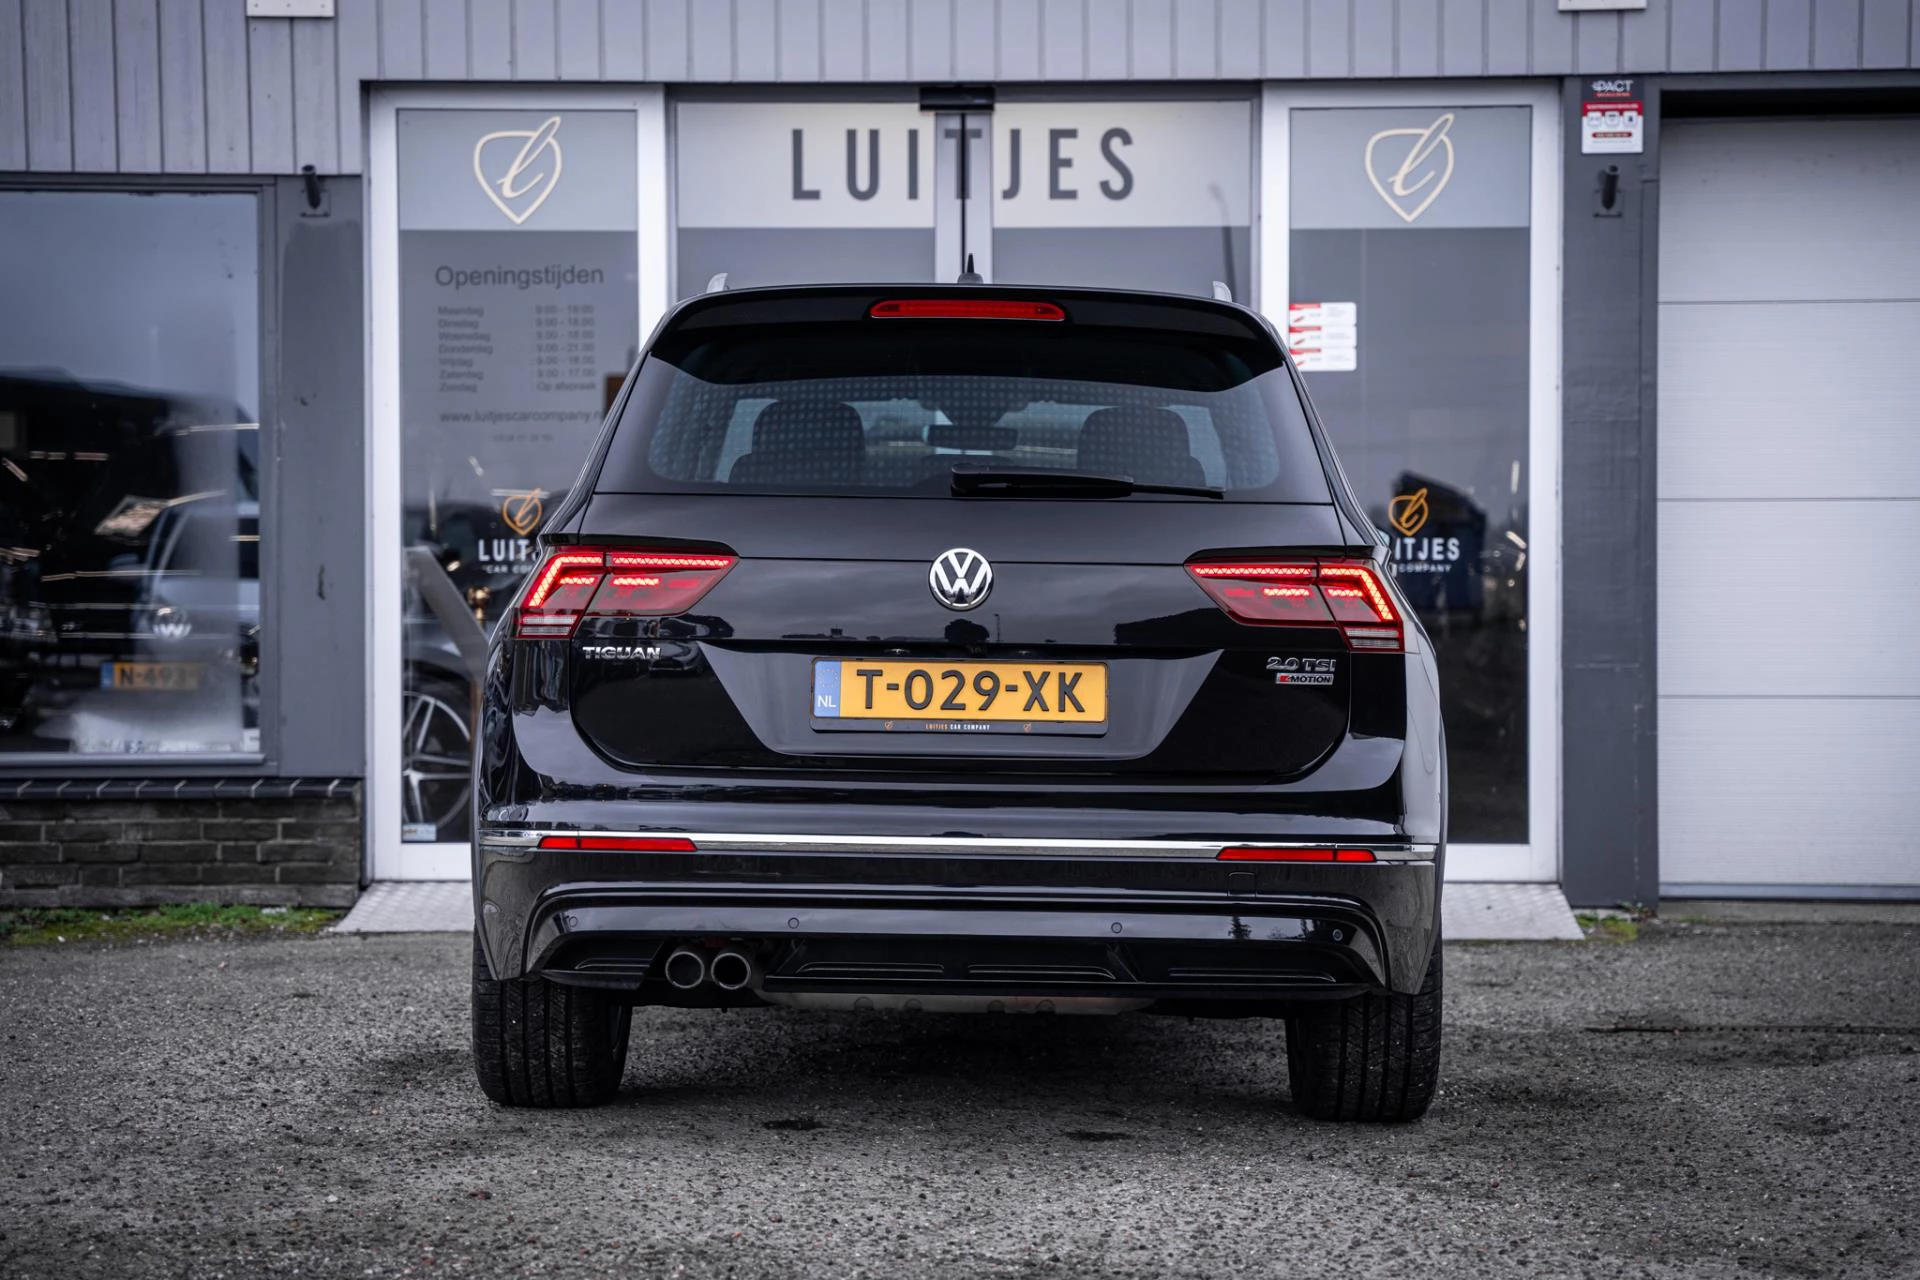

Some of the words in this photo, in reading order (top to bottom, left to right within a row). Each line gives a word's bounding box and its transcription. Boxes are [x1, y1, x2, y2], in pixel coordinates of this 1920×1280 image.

[791, 127, 1134, 201] LUITJES
[435, 264, 604, 290] Openingstijden
[440, 409, 602, 424] www.luitjescarcompany.n
[1394, 537, 1460, 561] ITJES
[1398, 563, 1451, 573] COMPANY
[582, 646, 661, 660] TIGUAN
[1302, 658, 1337, 672] TSI
[856, 669, 1085, 712] T-029-XK
[817, 695, 836, 708] NL
[950, 723, 961, 731] CAR
